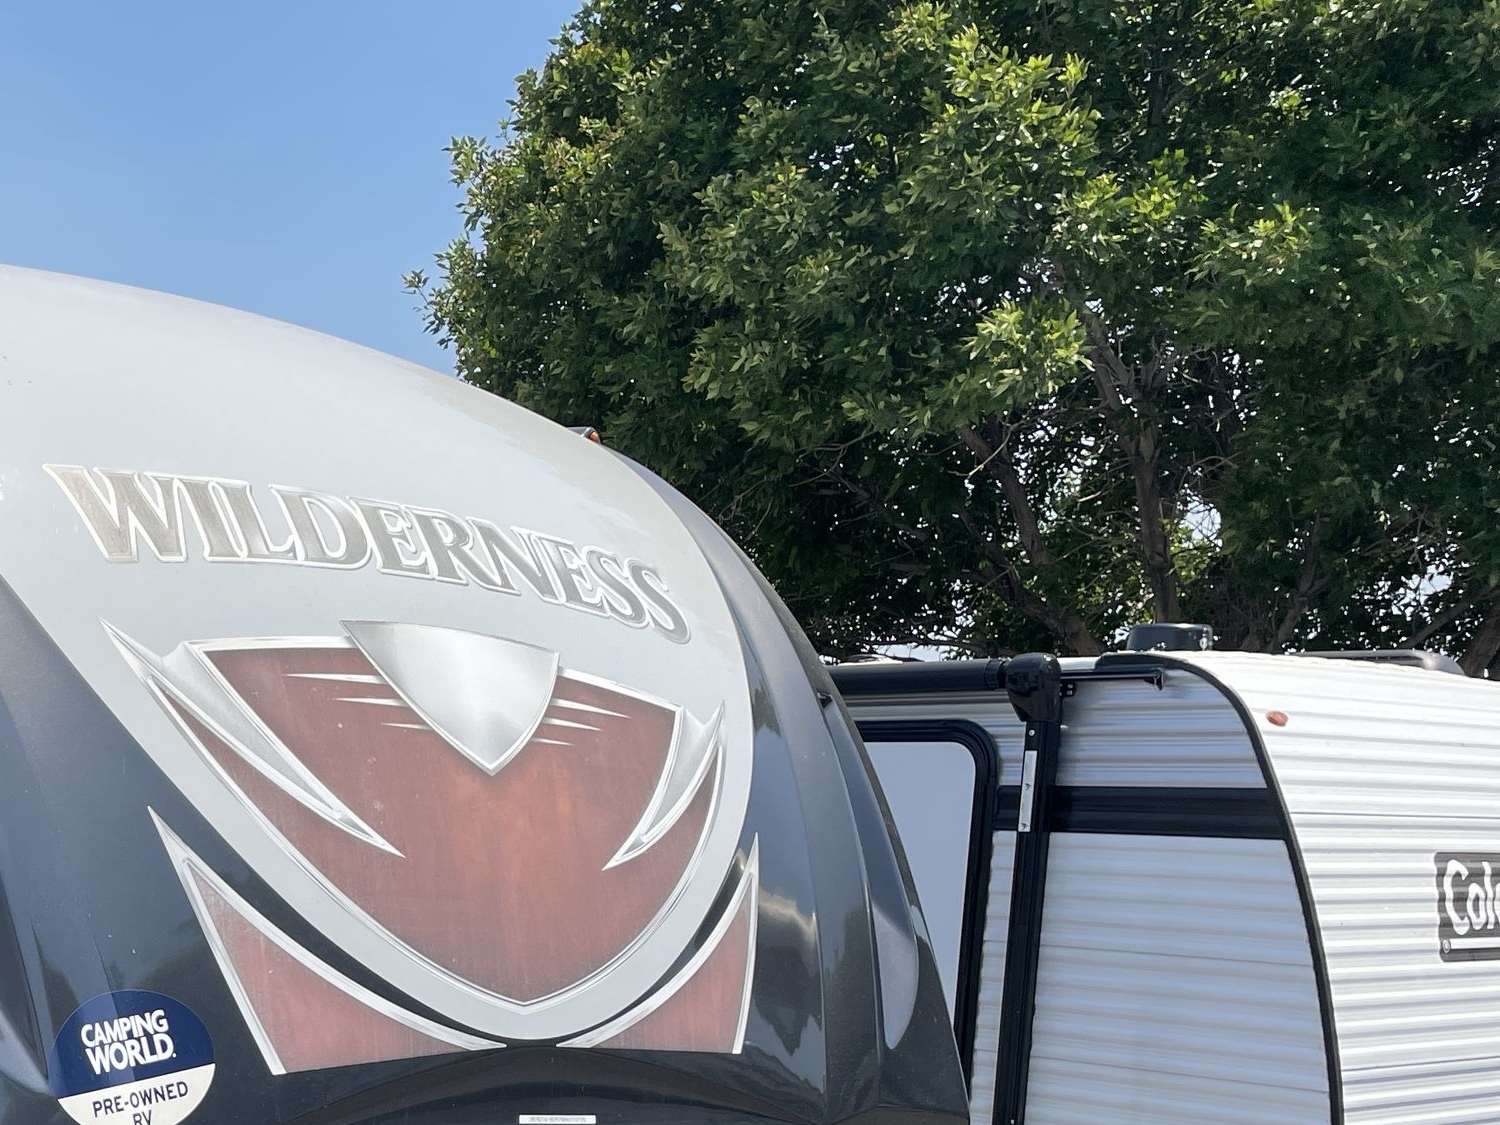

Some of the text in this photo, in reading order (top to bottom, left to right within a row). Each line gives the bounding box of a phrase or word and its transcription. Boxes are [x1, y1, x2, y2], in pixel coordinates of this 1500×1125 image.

[43, 464, 691, 643] WILDERNESS
[81, 1009, 169, 1048] CAMPING
[92, 1081, 189, 1118] PRE-OWNED
